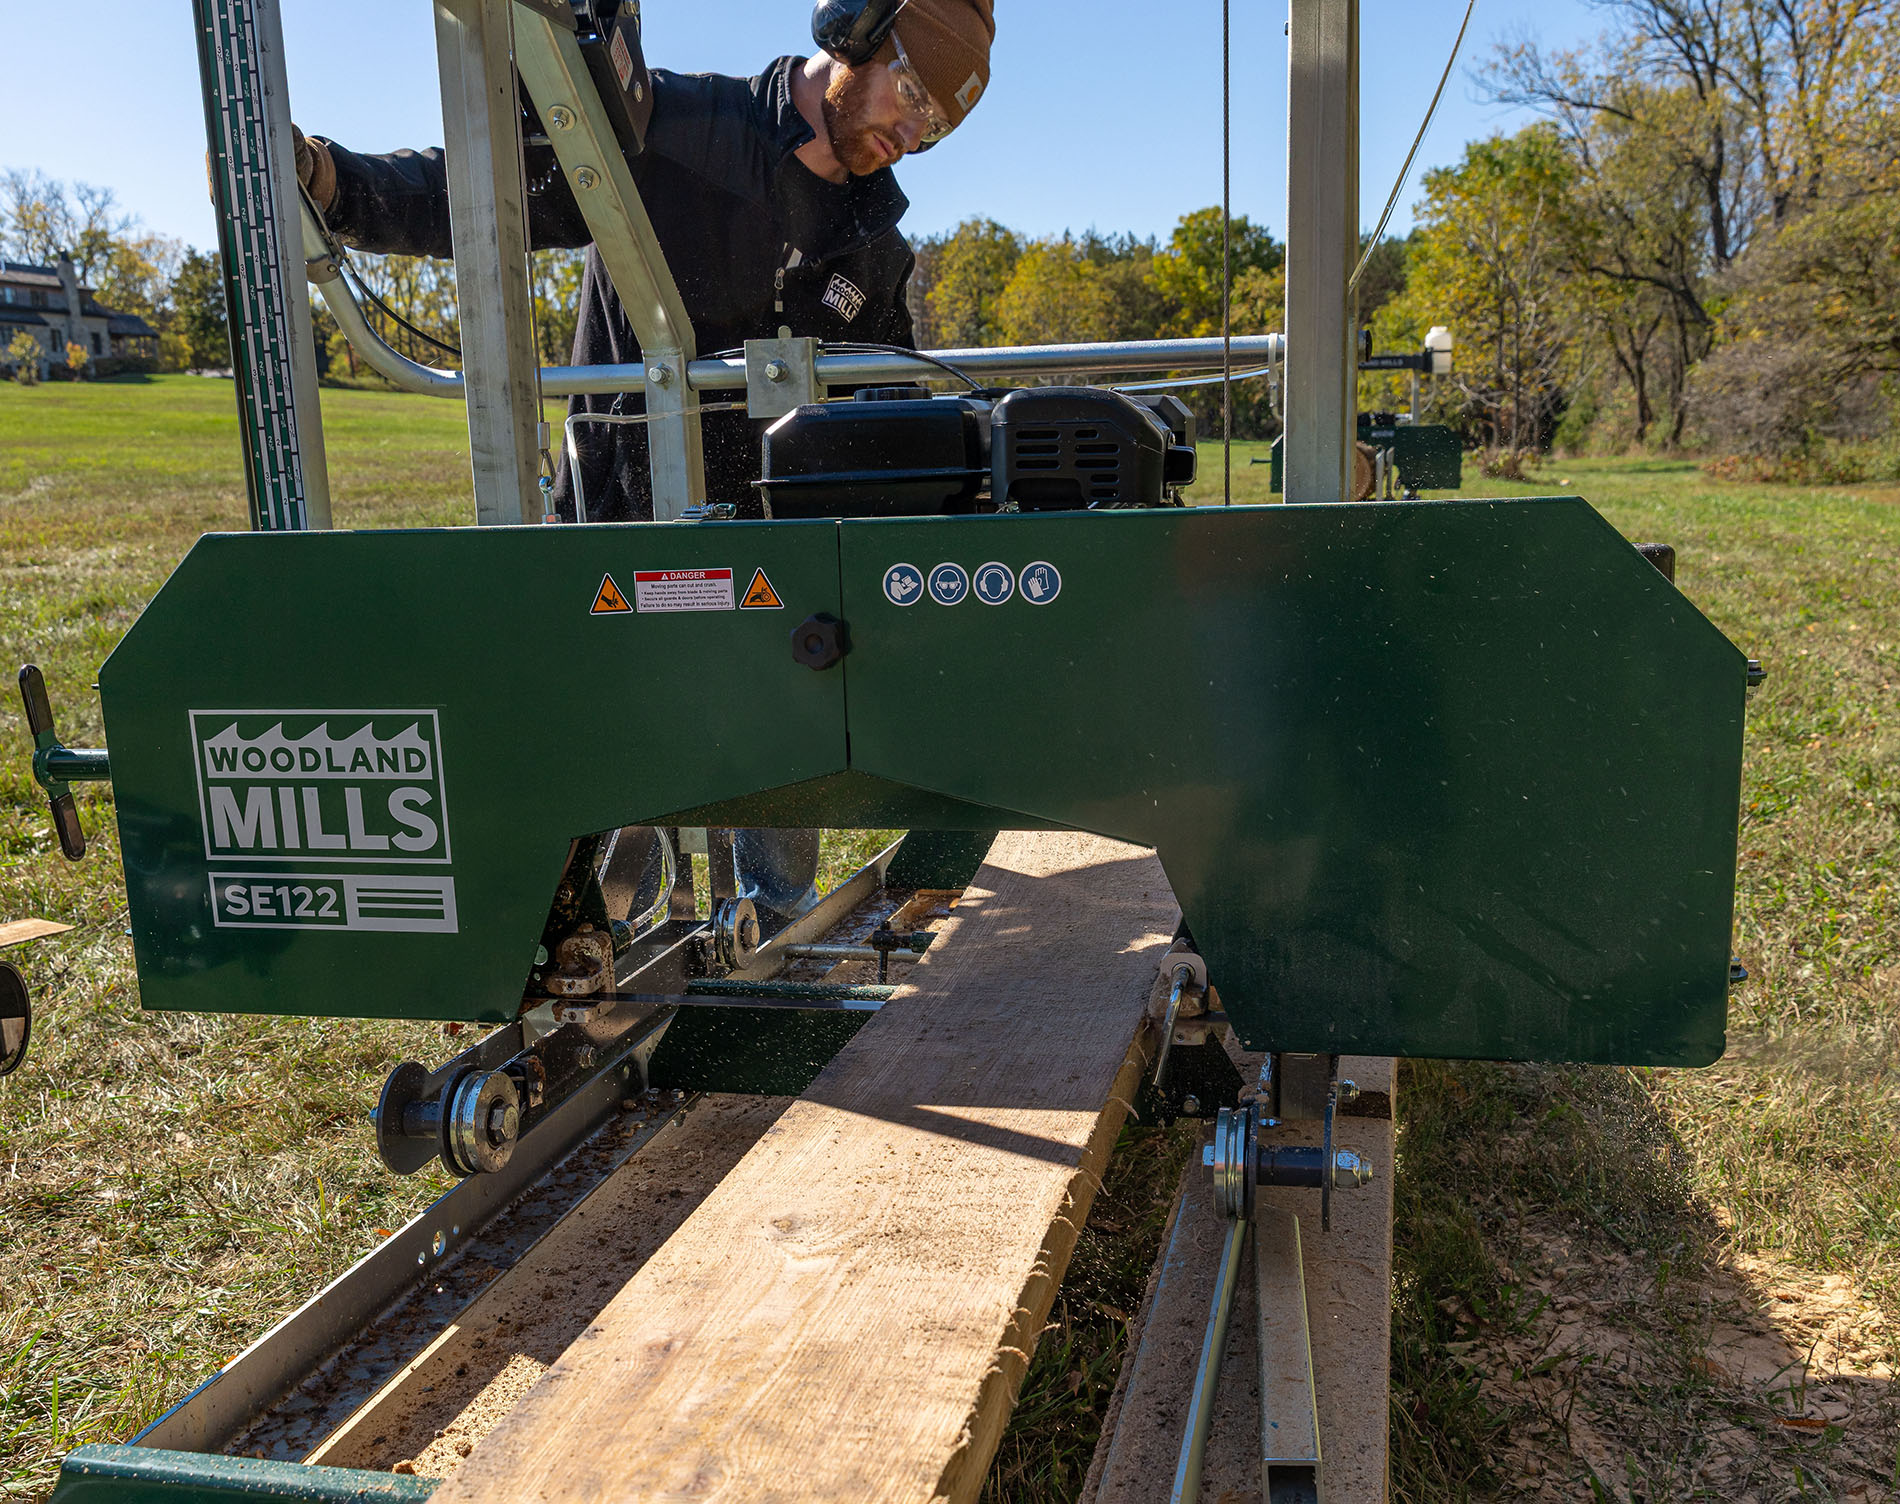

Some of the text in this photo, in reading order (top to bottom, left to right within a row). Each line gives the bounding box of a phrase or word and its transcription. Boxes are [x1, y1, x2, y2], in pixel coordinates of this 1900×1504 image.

[670, 571, 706, 579] DANGER
[208, 746, 426, 773] WOODLAND
[208, 786, 438, 852] MILLS
[224, 884, 340, 918] SE122
